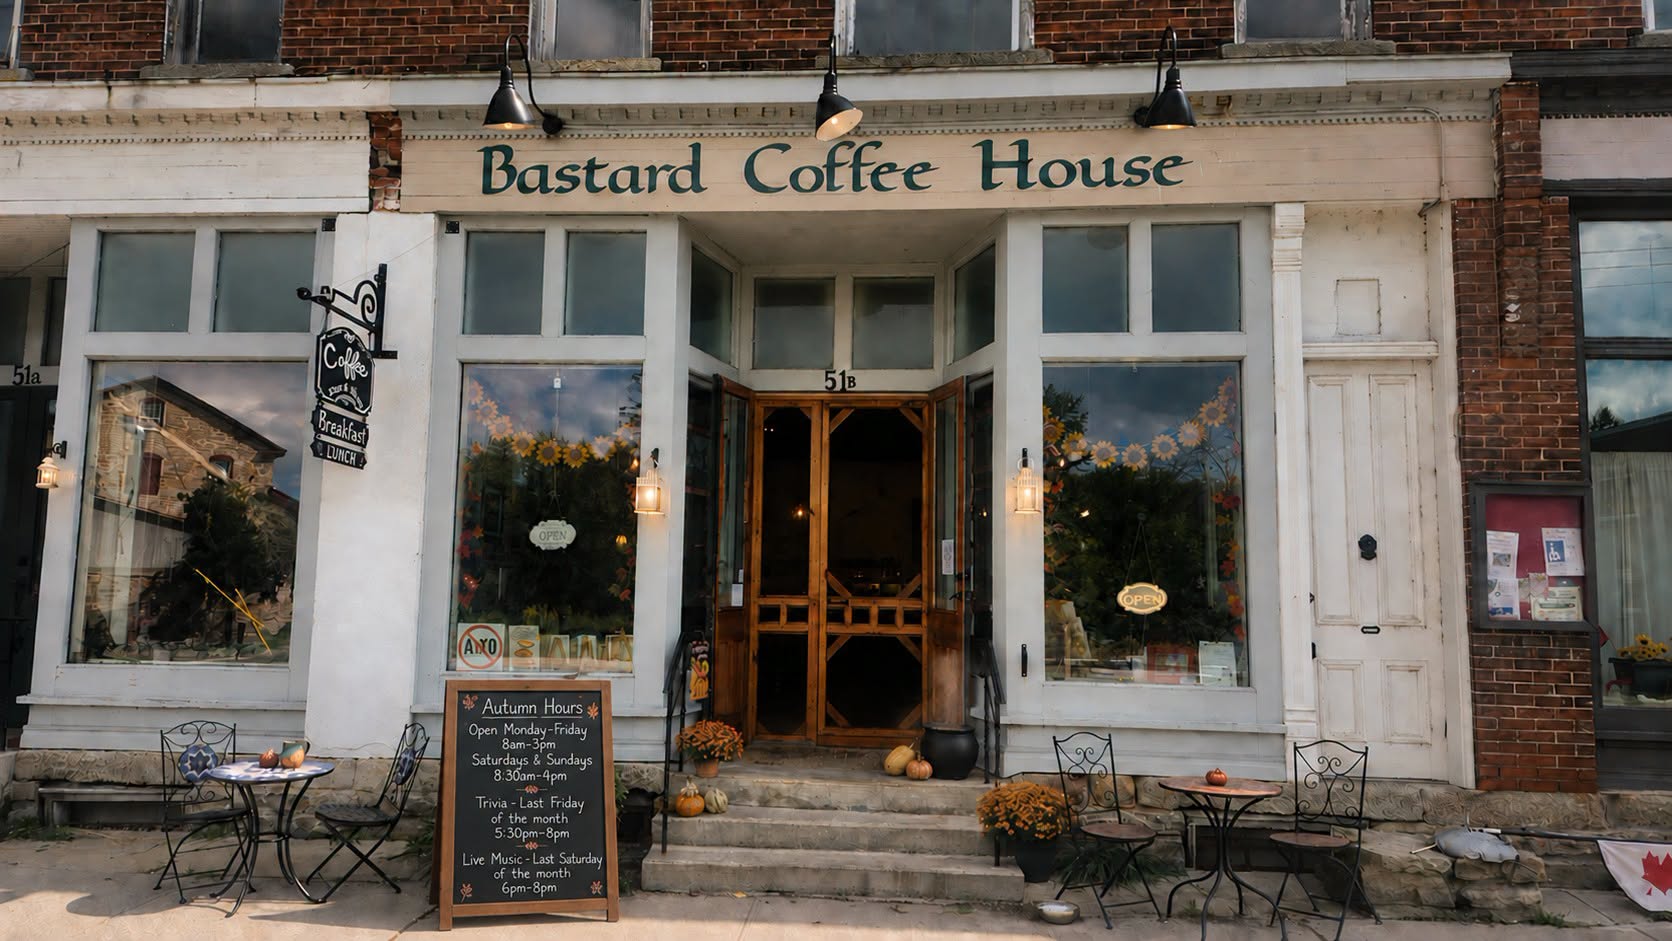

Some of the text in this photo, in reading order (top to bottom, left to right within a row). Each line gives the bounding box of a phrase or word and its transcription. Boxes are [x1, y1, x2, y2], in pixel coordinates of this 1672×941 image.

[478, 139, 1193, 195] Bastard Coffee House
[324, 343, 368, 381] Coffee
[12, 364, 42, 386] 51a
[825, 369, 857, 392] 51B
[318, 409, 367, 446] Breakfast
[326, 447, 357, 467] LUNCH
[539, 530, 567, 541] OPEN
[1123, 594, 1163, 606] OPEN
[481, 697, 583, 716] Autumn Hours
[468, 722, 588, 740] Open Monday-Friday
[502, 738, 556, 753] 8am-3pm
[472, 751, 593, 770] Saturdays & Sundays
[493, 769, 567, 785] 8:30am-4pm
[475, 796, 508, 809] Trivia
[519, 797, 544, 809] Last
[551, 796, 585, 814] Friday
[491, 811, 568, 824] of the month
[495, 827, 570, 843] 5:30pm-8pm
[462, 853, 485, 866] Live
[491, 852, 523, 865] Music
[533, 853, 554, 865] Last
[559, 852, 603, 870] Saturday
[494, 868, 571, 879] of the month
[502, 882, 557, 897] 6pm-8pm
